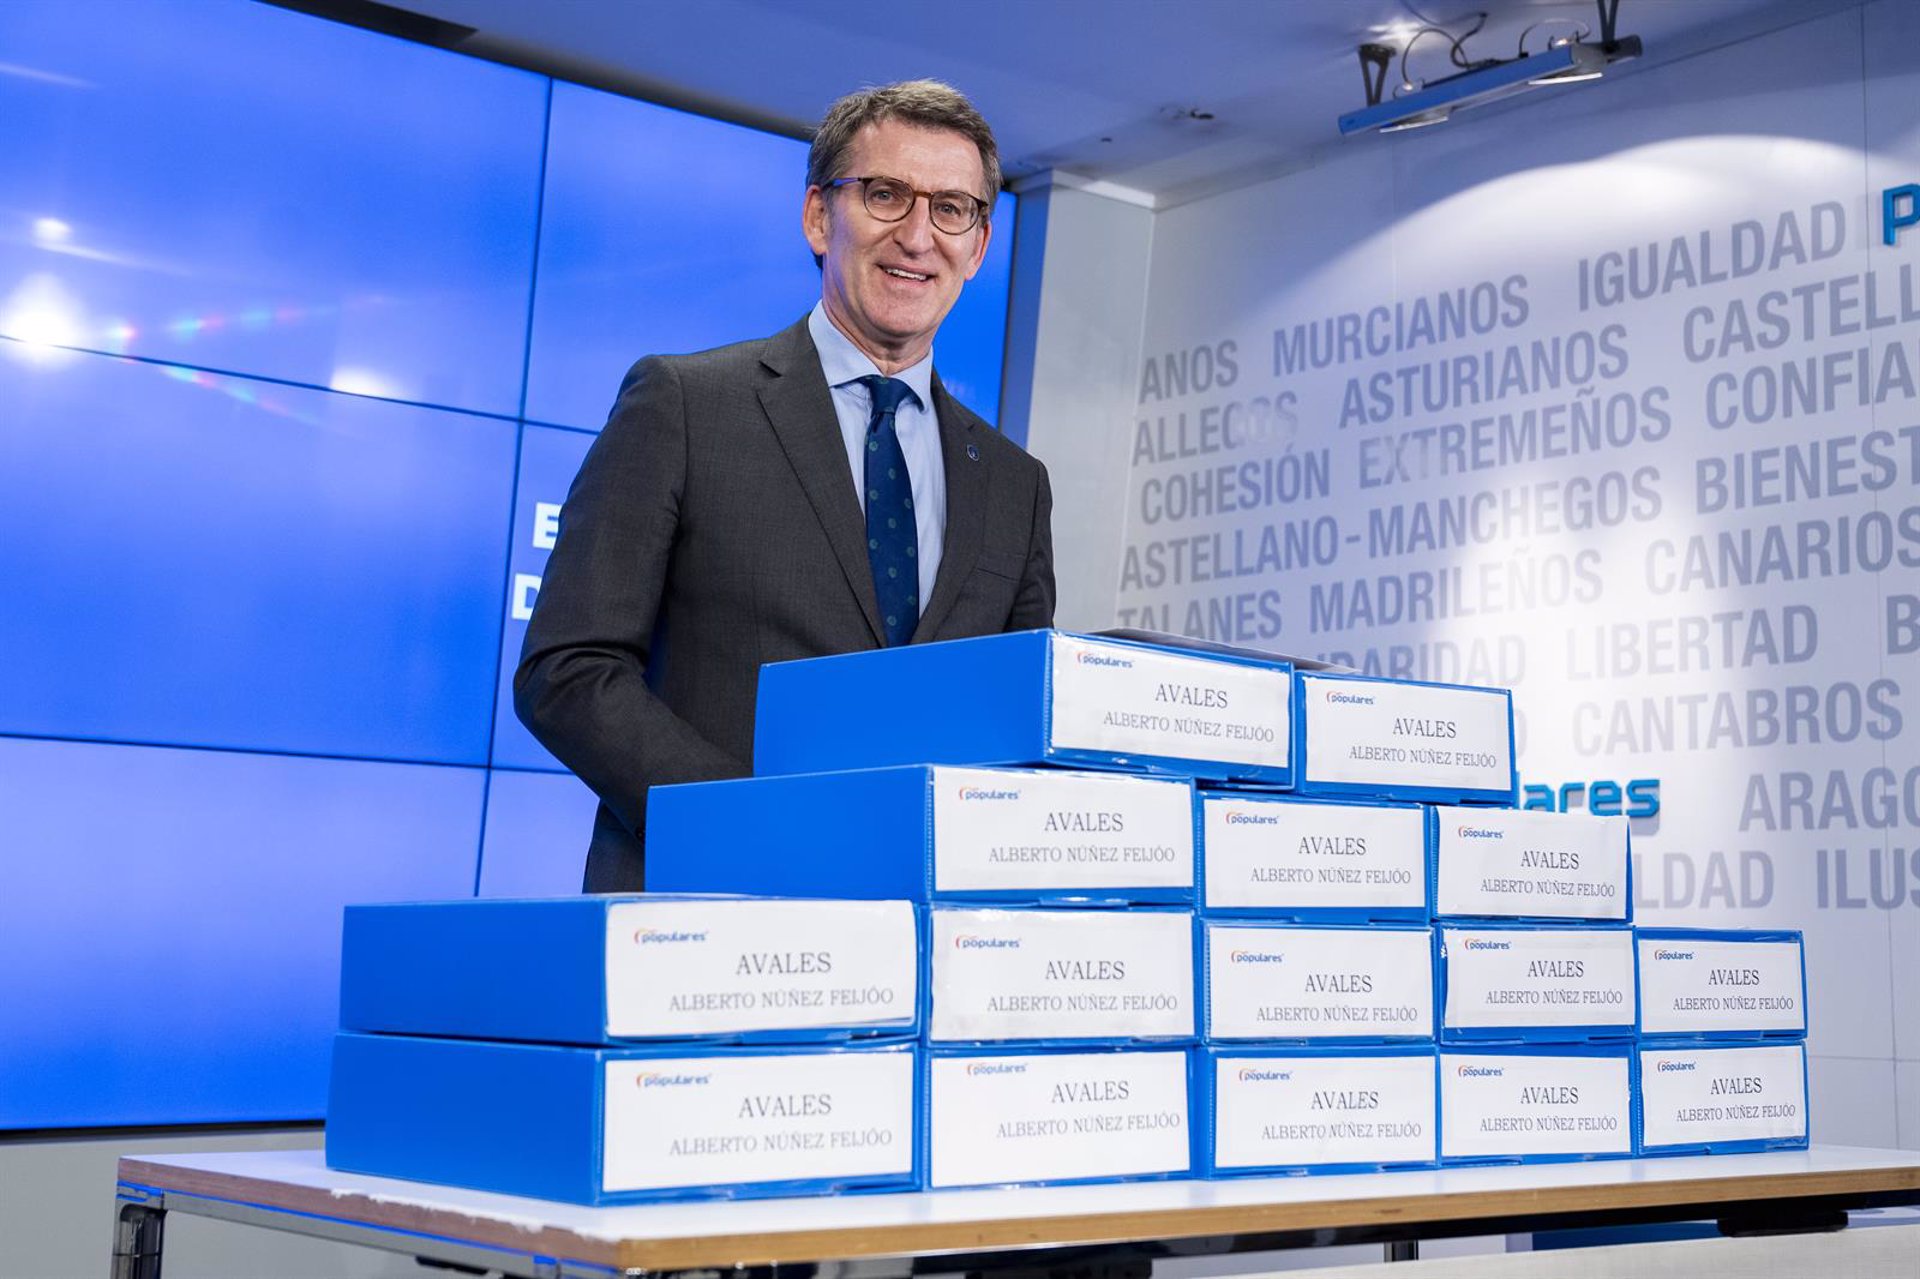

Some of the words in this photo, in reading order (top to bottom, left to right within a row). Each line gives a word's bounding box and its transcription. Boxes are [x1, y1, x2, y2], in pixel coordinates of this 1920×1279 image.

[1139, 339, 1239, 405] ANOS
[1273, 274, 1529, 378] MURCIANOS
[1578, 201, 1845, 312] IGUALDAD
[1338, 324, 1628, 430] ASTURIANOS
[1140, 443, 1330, 526] COHESIÓN
[1358, 386, 1672, 490] EXTREMEÑOS
[1120, 466, 1662, 592] ASTELLANO-MANCHEGOS
[1309, 543, 1603, 634] MADRILEÑOS
[1645, 506, 1920, 595] CANARIOS
[1566, 604, 1818, 681] LIBERTAD
[1083, 654, 1132, 668] populares
[1155, 684, 1227, 708] AVALES
[1330, 692, 1373, 704] populares
[1572, 678, 1904, 757] CANTABROS
[1104, 712, 1169, 731] ALBERTO
[1174, 718, 1221, 737] NÚÑEZ
[1226, 724, 1274, 742] FEIJÓO
[1393, 718, 1456, 738] AVALES
[1349, 746, 1406, 762] ALBERTO
[1410, 749, 1451, 765] NÚÑEZ
[1456, 752, 1496, 768] FEIJÓO
[966, 788, 1020, 800] populares
[1045, 812, 1123, 831] AVALES
[1230, 813, 1279, 824] populares
[1463, 828, 1503, 839] populares
[989, 847, 1062, 862] ALBERTO
[1068, 845, 1118, 862] NÚÑEZ
[1123, 846, 1175, 862] FEIJÓO
[1299, 837, 1366, 855] AVALES
[1521, 851, 1579, 870] AVALES
[1251, 868, 1313, 882] ALBERTO
[1319, 867, 1361, 883] NÚÑEZ
[1366, 868, 1411, 884] FEIJÓO
[1481, 879, 1533, 893] ALBERTO
[1537, 879, 1574, 895] NÚÑEZ
[1577, 883, 1615, 897] FEIJÓO
[642, 932, 705, 944] populares
[963, 938, 1019, 949] populares
[1470, 939, 1511, 950] populares
[736, 952, 831, 975] AVALES
[1237, 952, 1283, 963] populares
[1657, 950, 1694, 960] populares
[1046, 961, 1125, 980] AVALES
[1528, 961, 1584, 977] AVALES
[1709, 969, 1759, 985] AVALES
[1305, 974, 1372, 993] AVALES
[669, 992, 755, 1011] ALBERTO
[762, 989, 823, 1008] NÚÑEZ
[831, 987, 893, 1006] FEIJÓO
[988, 996, 1062, 1011] ALBERTO
[1068, 993, 1118, 1011] NÚÑEZ
[1123, 994, 1177, 1010] FEIJÓO
[1486, 991, 1539, 1003] ALBERTO
[1543, 989, 1579, 1004] NÚÑEZ
[1583, 989, 1623, 1004] FEIJÓO
[1673, 998, 1720, 1010] ALBERTO
[1723, 996, 1756, 1010] NÚÑEZ
[1759, 996, 1793, 1009] FEIJÓO
[1257, 1007, 1319, 1021] ALBERTO
[1324, 1005, 1368, 1021] NÚÑEZ
[1373, 1006, 1417, 1021] FEIJÓO
[973, 1063, 1027, 1075] populares
[1245, 1070, 1290, 1081] populares
[1463, 1066, 1503, 1077] populares
[1660, 1061, 1696, 1072] populares
[644, 1075, 708, 1087] populares
[1711, 1077, 1762, 1094] AVALES
[1052, 1081, 1129, 1103] AVALES
[1312, 1091, 1378, 1109] AVALES
[1521, 1087, 1578, 1104] AVALES
[739, 1094, 831, 1118] AVALES
[1677, 1108, 1722, 1121] ALBERTO
[1726, 1105, 1759, 1119] NÚÑEZ
[1762, 1103, 1795, 1118] FEIJÓO
[997, 1120, 1068, 1138] ALBERTO
[1074, 1115, 1122, 1133] NÚÑEZ
[1128, 1112, 1180, 1130] FEIJÓO
[1262, 1125, 1326, 1139] ALBERTO
[1329, 1122, 1373, 1138] NÚÑEZ
[1377, 1121, 1421, 1138] FEIJÓO
[1480, 1118, 1533, 1131] ALBERTO
[1537, 1116, 1574, 1131] NÚÑEZ
[1578, 1116, 1617, 1131] FEIJÓO
[670, 1136, 757, 1156] ALBERTO
[764, 1131, 824, 1151] NÚÑEZ
[831, 1128, 892, 1148] FEIJÓO
